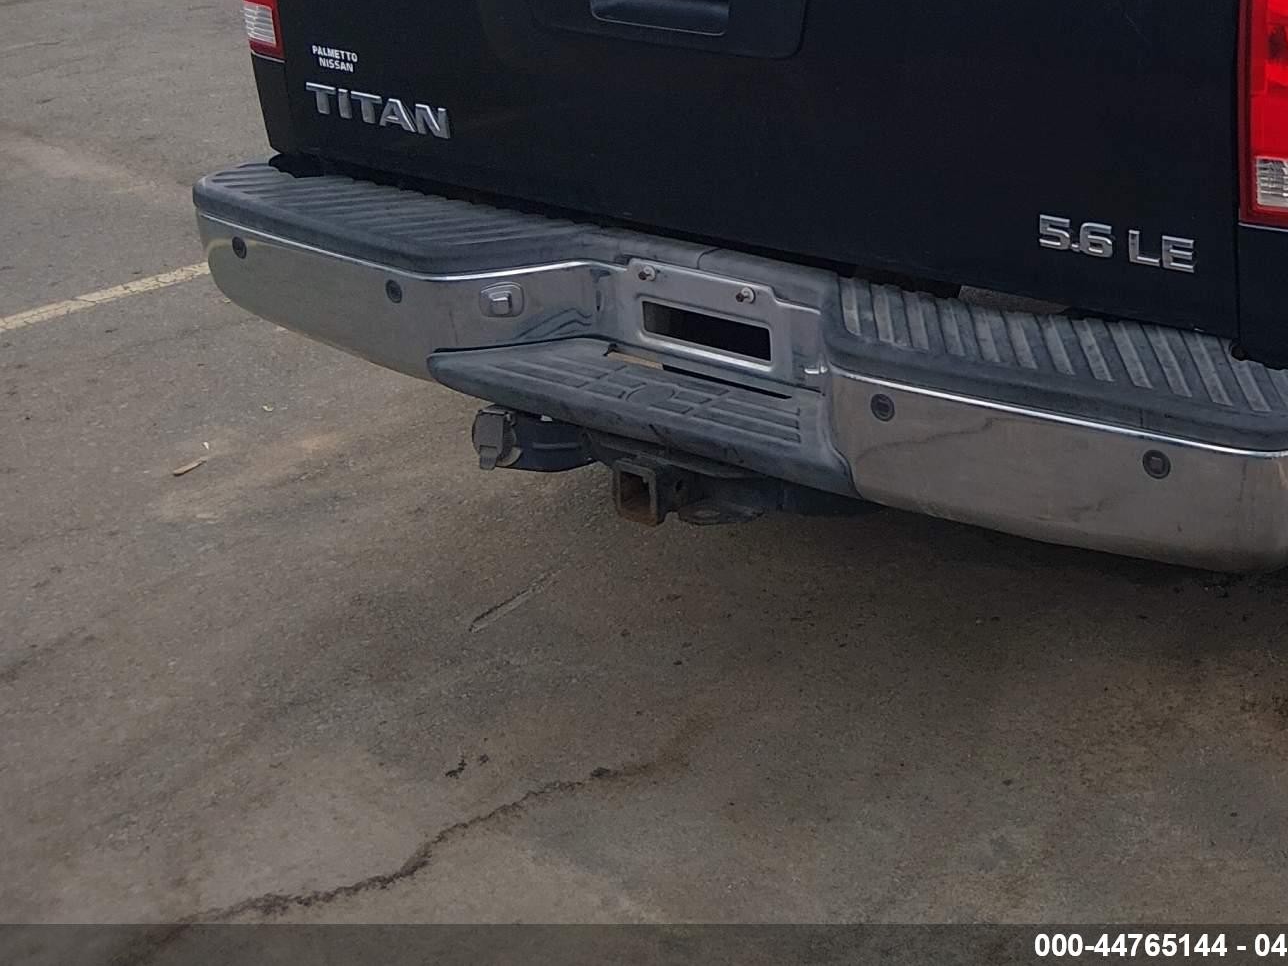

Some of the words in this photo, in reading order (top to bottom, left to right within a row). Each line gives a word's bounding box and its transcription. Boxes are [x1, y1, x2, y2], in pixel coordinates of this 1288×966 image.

[312, 45, 358, 62] PALMETTO
[318, 57, 354, 72] NISSAN
[305, 81, 451, 139] TITAN
[1038, 214, 1113, 258] 5.6
[1128, 229, 1195, 273] LE
